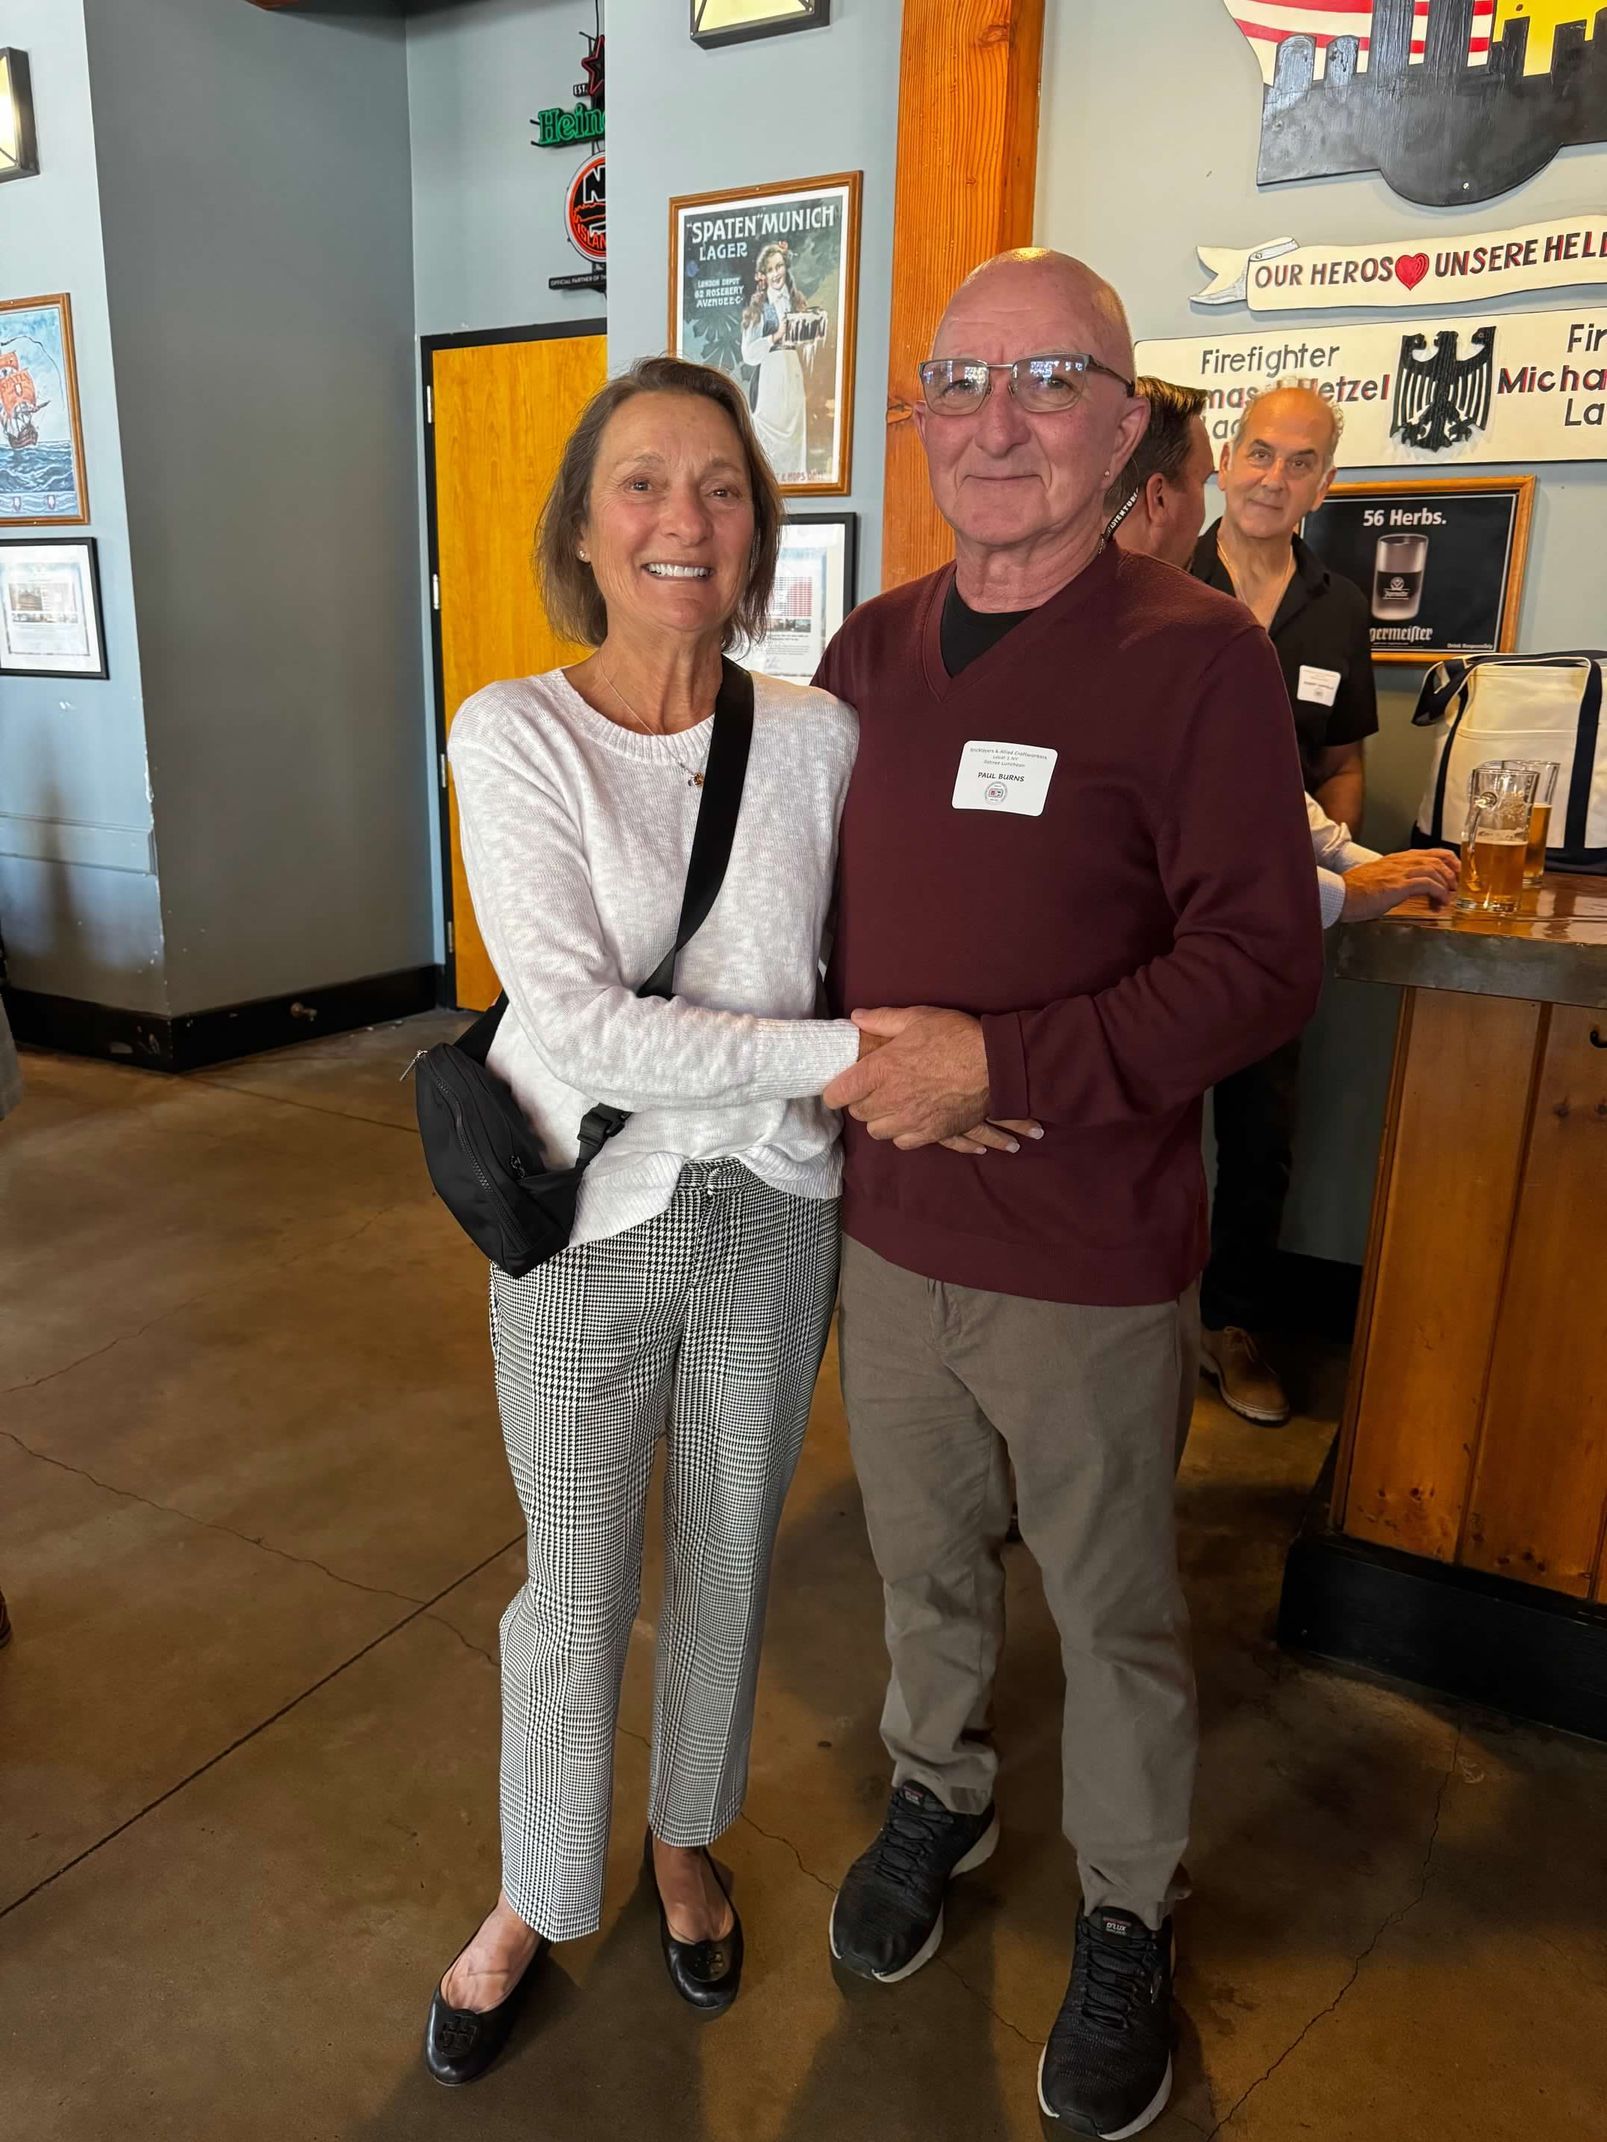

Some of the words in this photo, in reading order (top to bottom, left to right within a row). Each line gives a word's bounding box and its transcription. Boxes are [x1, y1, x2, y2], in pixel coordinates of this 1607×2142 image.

[539, 102, 605, 145] Hein
[762, 205, 835, 234] MUNICH
[699, 242, 748, 261] LAGER
[1255, 264, 1303, 289] OUR
[1310, 257, 1396, 287] HEROS
[1435, 239, 1538, 278] UNSERE
[1201, 343, 1340, 378] Firefighter
[1363, 509, 1384, 527] 56
[1389, 508, 1447, 526] Herbs.
[978, 771, 996, 779] PAUL
[998, 773, 1025, 782] BURNS
